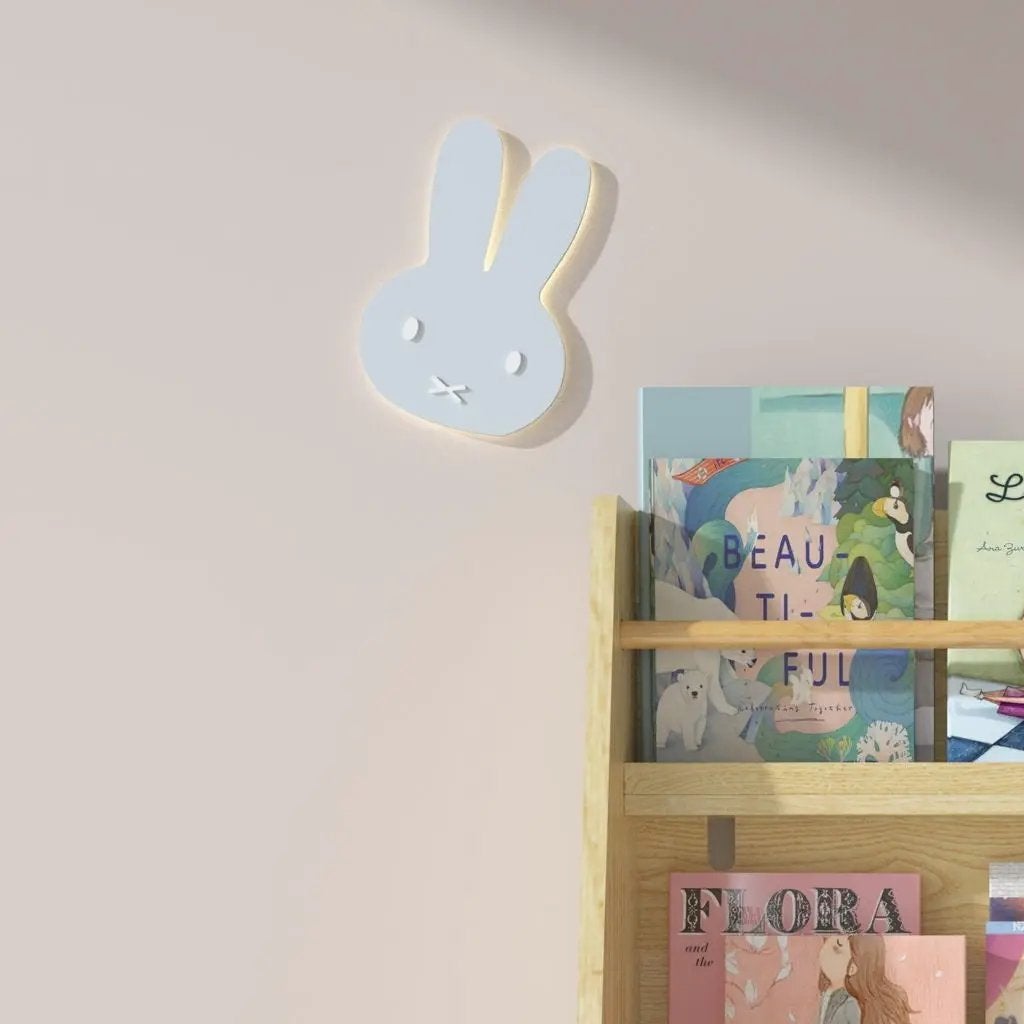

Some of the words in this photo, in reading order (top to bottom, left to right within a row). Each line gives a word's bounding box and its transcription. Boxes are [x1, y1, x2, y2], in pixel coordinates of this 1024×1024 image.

[723, 534, 849, 570] BEAU-
[783, 652, 850, 687] FUL
[679, 886, 912, 935] FLORA
[685, 942, 709, 953] and
[695, 956, 714, 967] the
